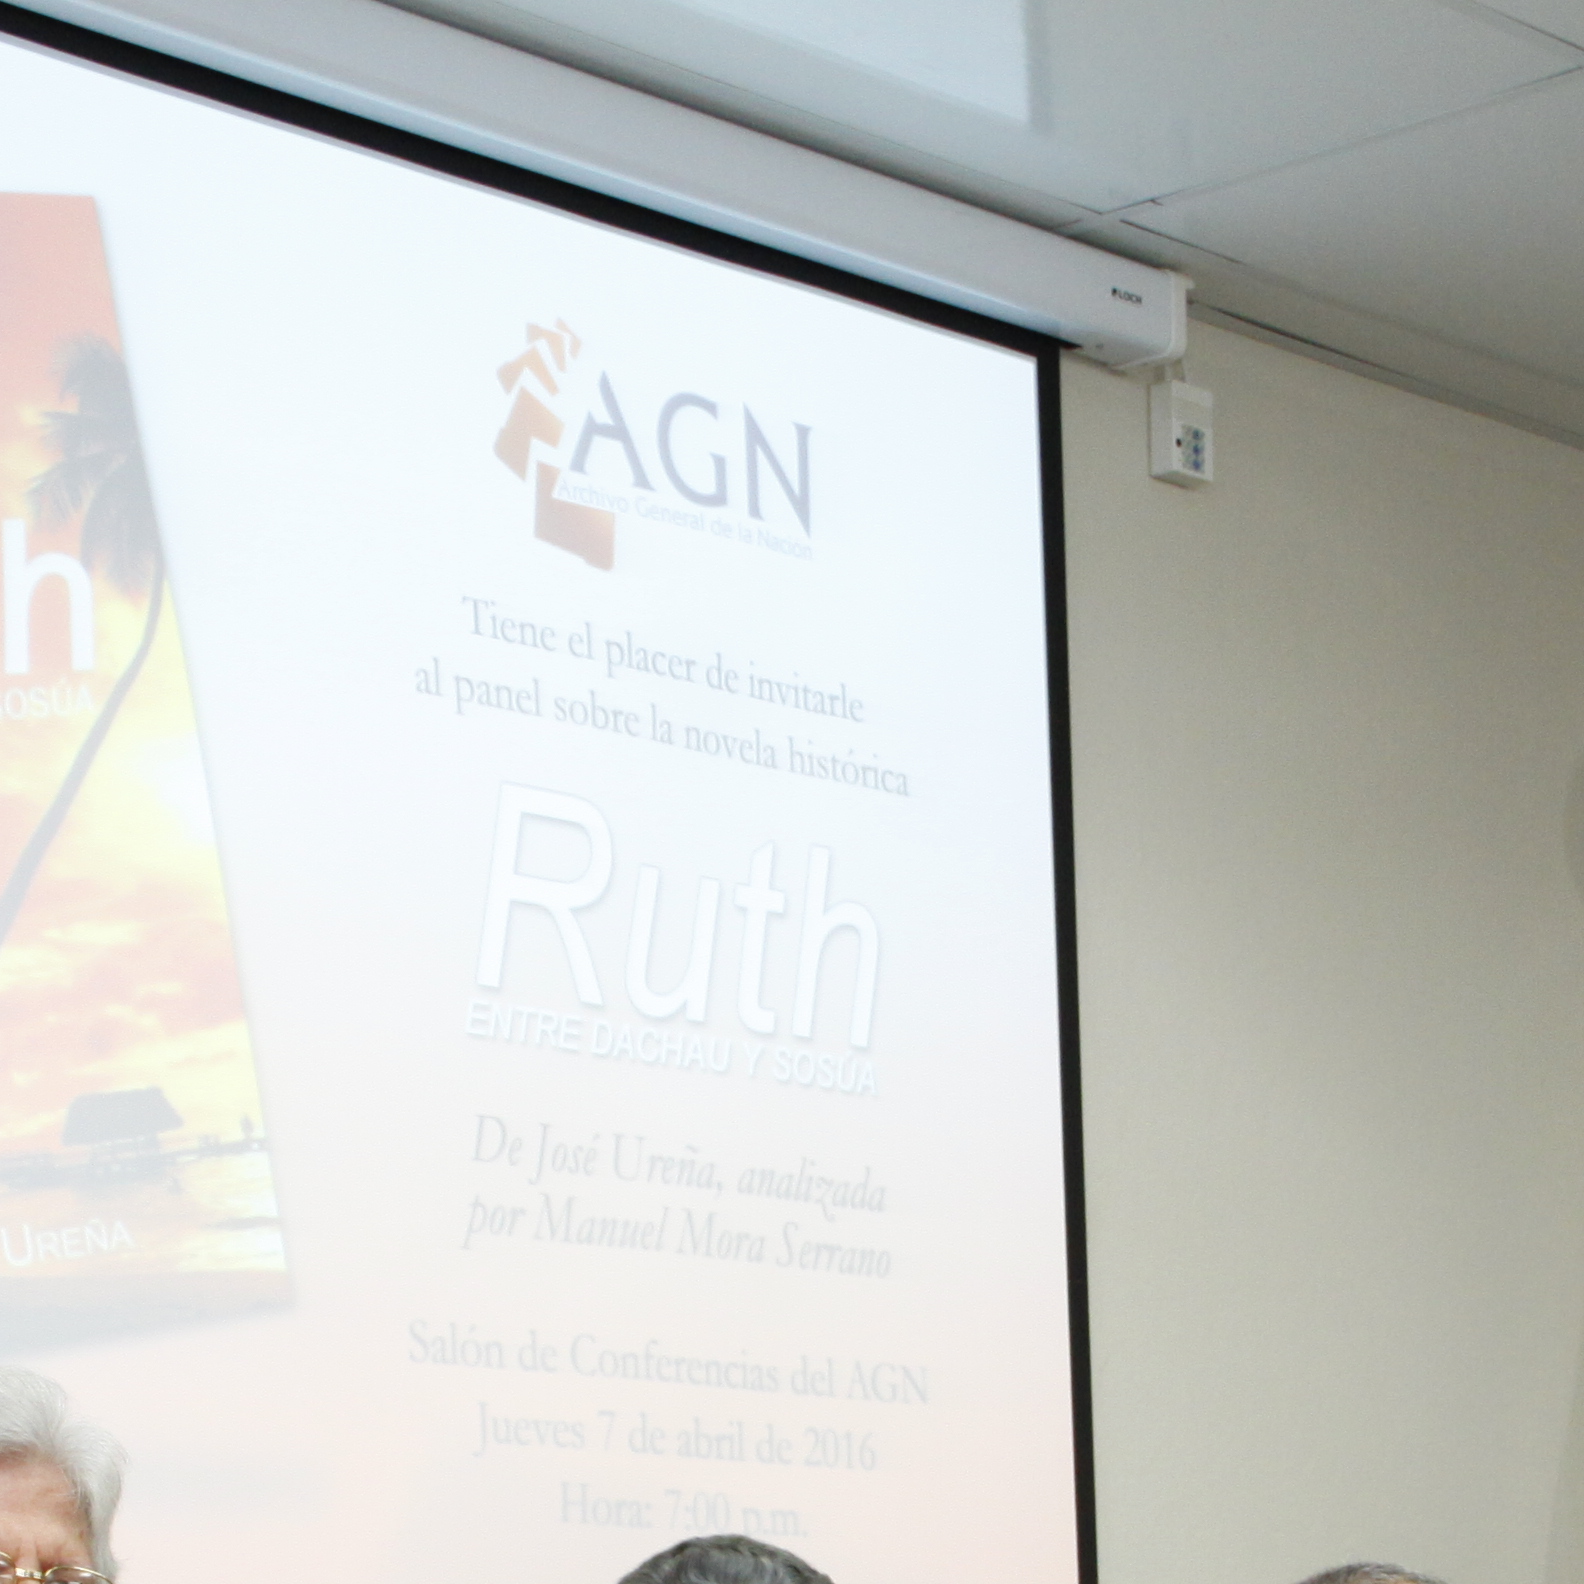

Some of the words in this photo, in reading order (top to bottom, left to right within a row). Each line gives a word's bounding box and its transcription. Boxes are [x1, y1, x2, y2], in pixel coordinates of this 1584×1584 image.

[569, 370, 814, 538] AGN
[558, 479, 630, 513] Archivo
[634, 495, 705, 532] General
[710, 516, 733, 539] de
[737, 522, 753, 545] la
[461, 595, 557, 652] Tiene
[567, 621, 594, 660] el
[606, 630, 698, 679] placer
[706, 652, 739, 694] de
[748, 659, 866, 723] invitarle
[415, 656, 442, 697] al
[453, 671, 543, 717] panel
[553, 689, 640, 737] sobre
[650, 702, 674, 745] la
[684, 721, 779, 771] novela
[787, 735, 911, 798] histórica
[475, 780, 883, 1053] Ruth
[464, 997, 583, 1052] ENTRE
[590, 1023, 731, 1074] DACHAU
[743, 1043, 765, 1077] Y
[770, 1050, 879, 1098] SOSÚA
[472, 1113, 524, 1167] De
[527, 1121, 601, 1186] José
[612, 1132, 724, 1198] Ureña,
[737, 1155, 888, 1222] analizada
[460, 1193, 526, 1250] por
[533, 1191, 670, 1253] Manuel
[676, 1207, 766, 1264] Mora
[774, 1220, 892, 1280] Serrano
[407, 1319, 507, 1370] Salón
[517, 1330, 558, 1375] de
[569, 1333, 780, 1394] Conferencias
[789, 1355, 836, 1399] del
[847, 1360, 931, 1405] AGN
[472, 1401, 586, 1458] Jueves
[597, 1409, 617, 1452] 7
[628, 1414, 667, 1458] de
[676, 1418, 747, 1465] abril
[755, 1424, 794, 1467] de
[803, 1427, 878, 1472] 2016
[560, 1481, 653, 1529] Hora:
[663, 1488, 732, 1533] 7:00
